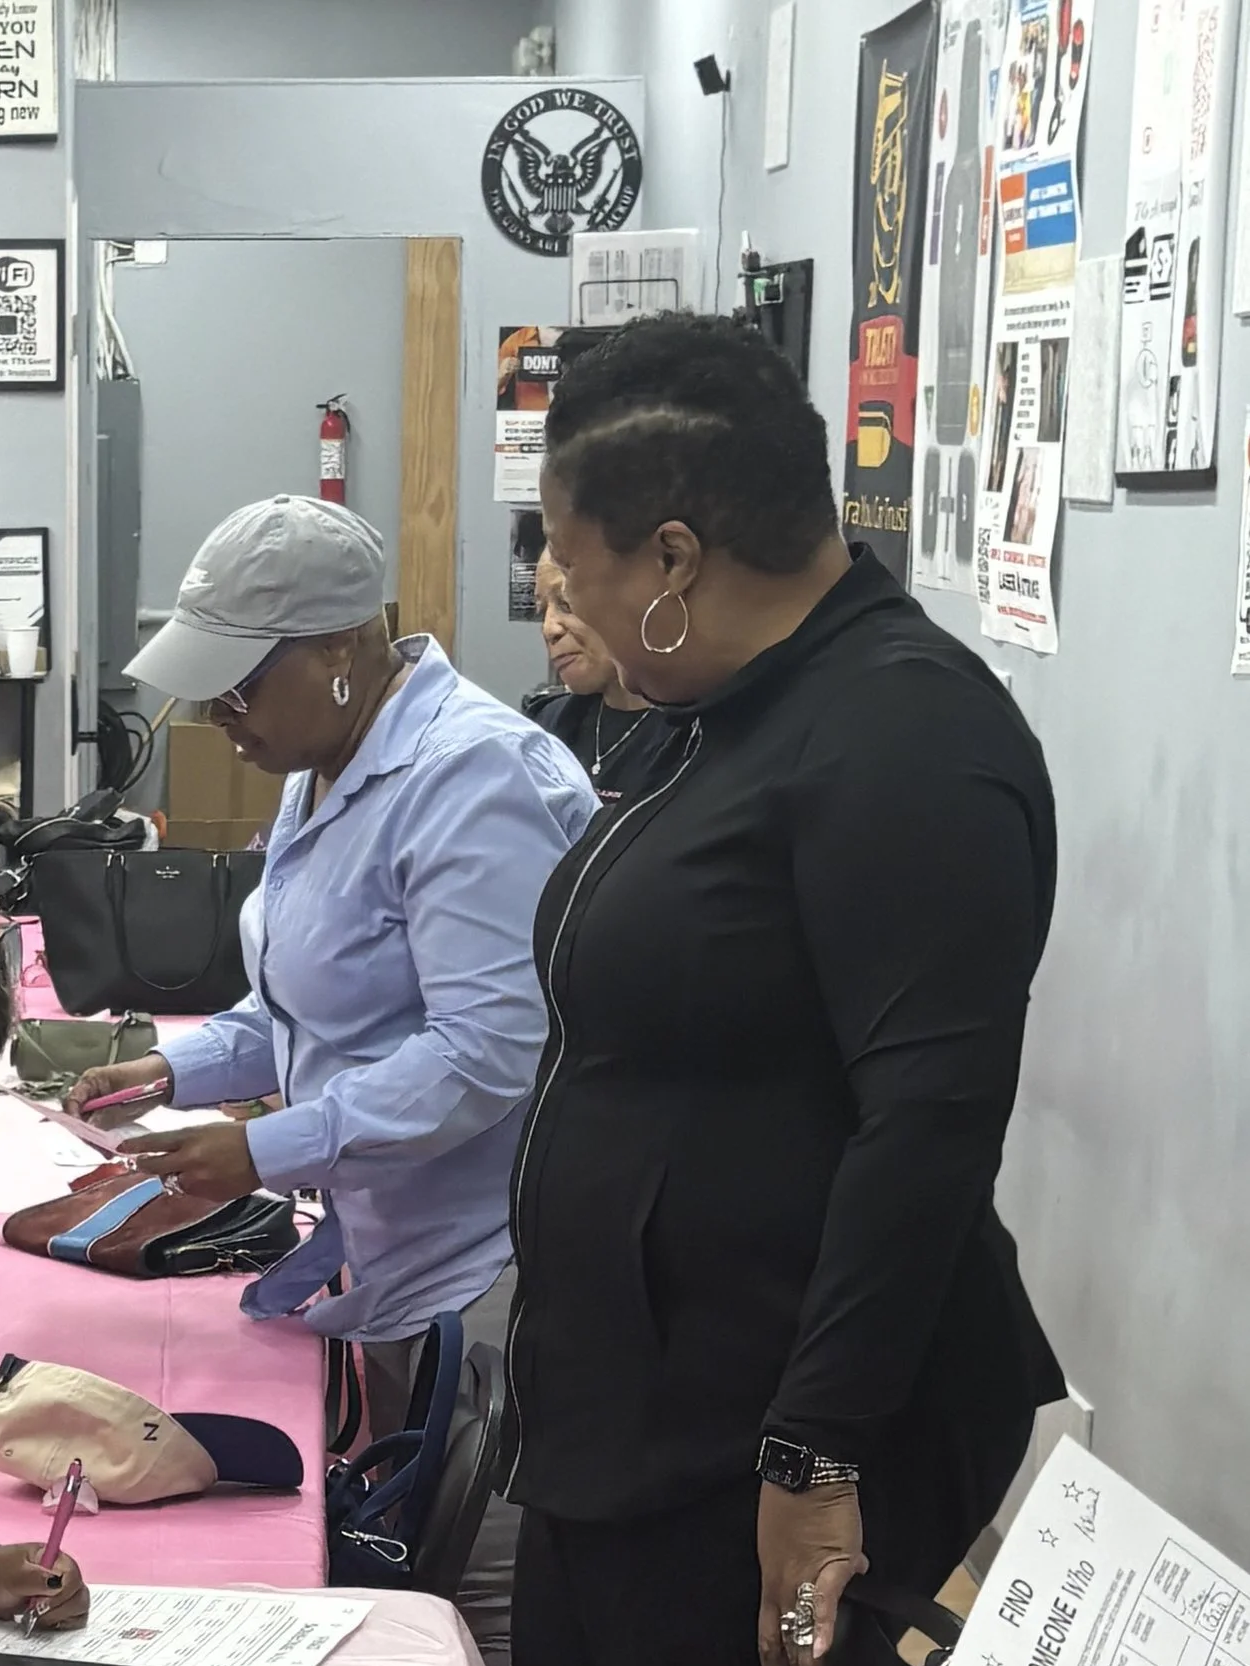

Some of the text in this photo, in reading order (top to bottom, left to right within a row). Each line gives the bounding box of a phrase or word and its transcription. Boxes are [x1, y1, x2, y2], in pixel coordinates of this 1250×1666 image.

[10, 107, 41, 121] new
[487, 91, 639, 161] IN GOD WE TRUST
[1061, 1560, 1095, 1600] Who
[998, 1578, 1034, 1628] FIND
